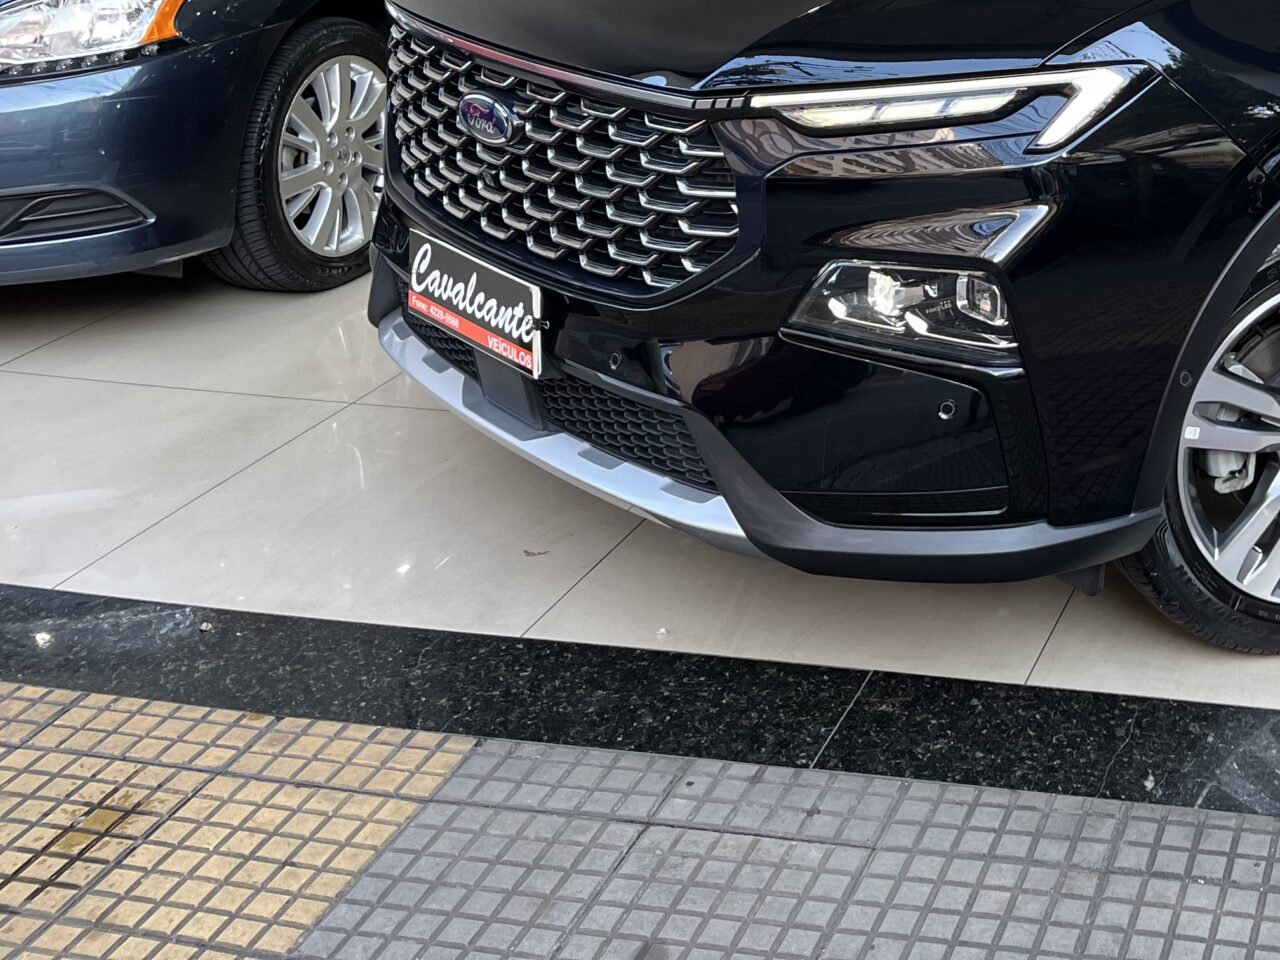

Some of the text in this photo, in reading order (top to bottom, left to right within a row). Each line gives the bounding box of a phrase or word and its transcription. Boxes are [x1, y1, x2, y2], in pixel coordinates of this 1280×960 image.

[467, 103, 496, 134] Ford
[411, 243, 534, 343] Cavalcante
[487, 335, 533, 368] VEÍCULOS
